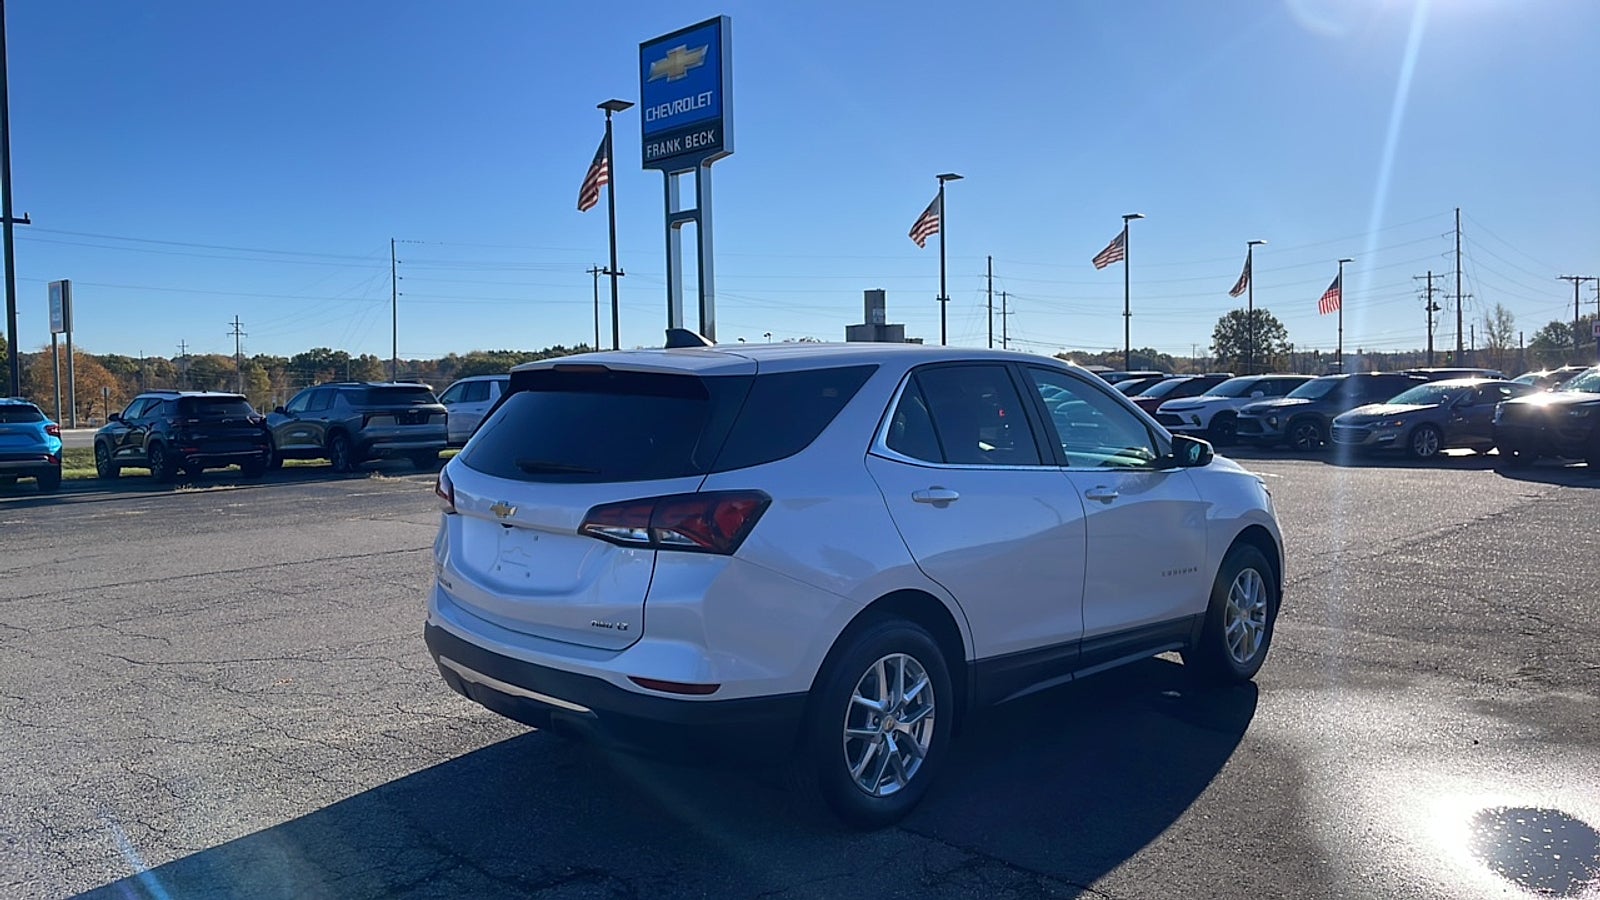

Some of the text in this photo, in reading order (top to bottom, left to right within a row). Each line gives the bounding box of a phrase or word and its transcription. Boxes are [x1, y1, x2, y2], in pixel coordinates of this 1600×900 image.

[645, 91, 713, 122] CHEVROLET
[646, 129, 715, 158] FRANK BECK
